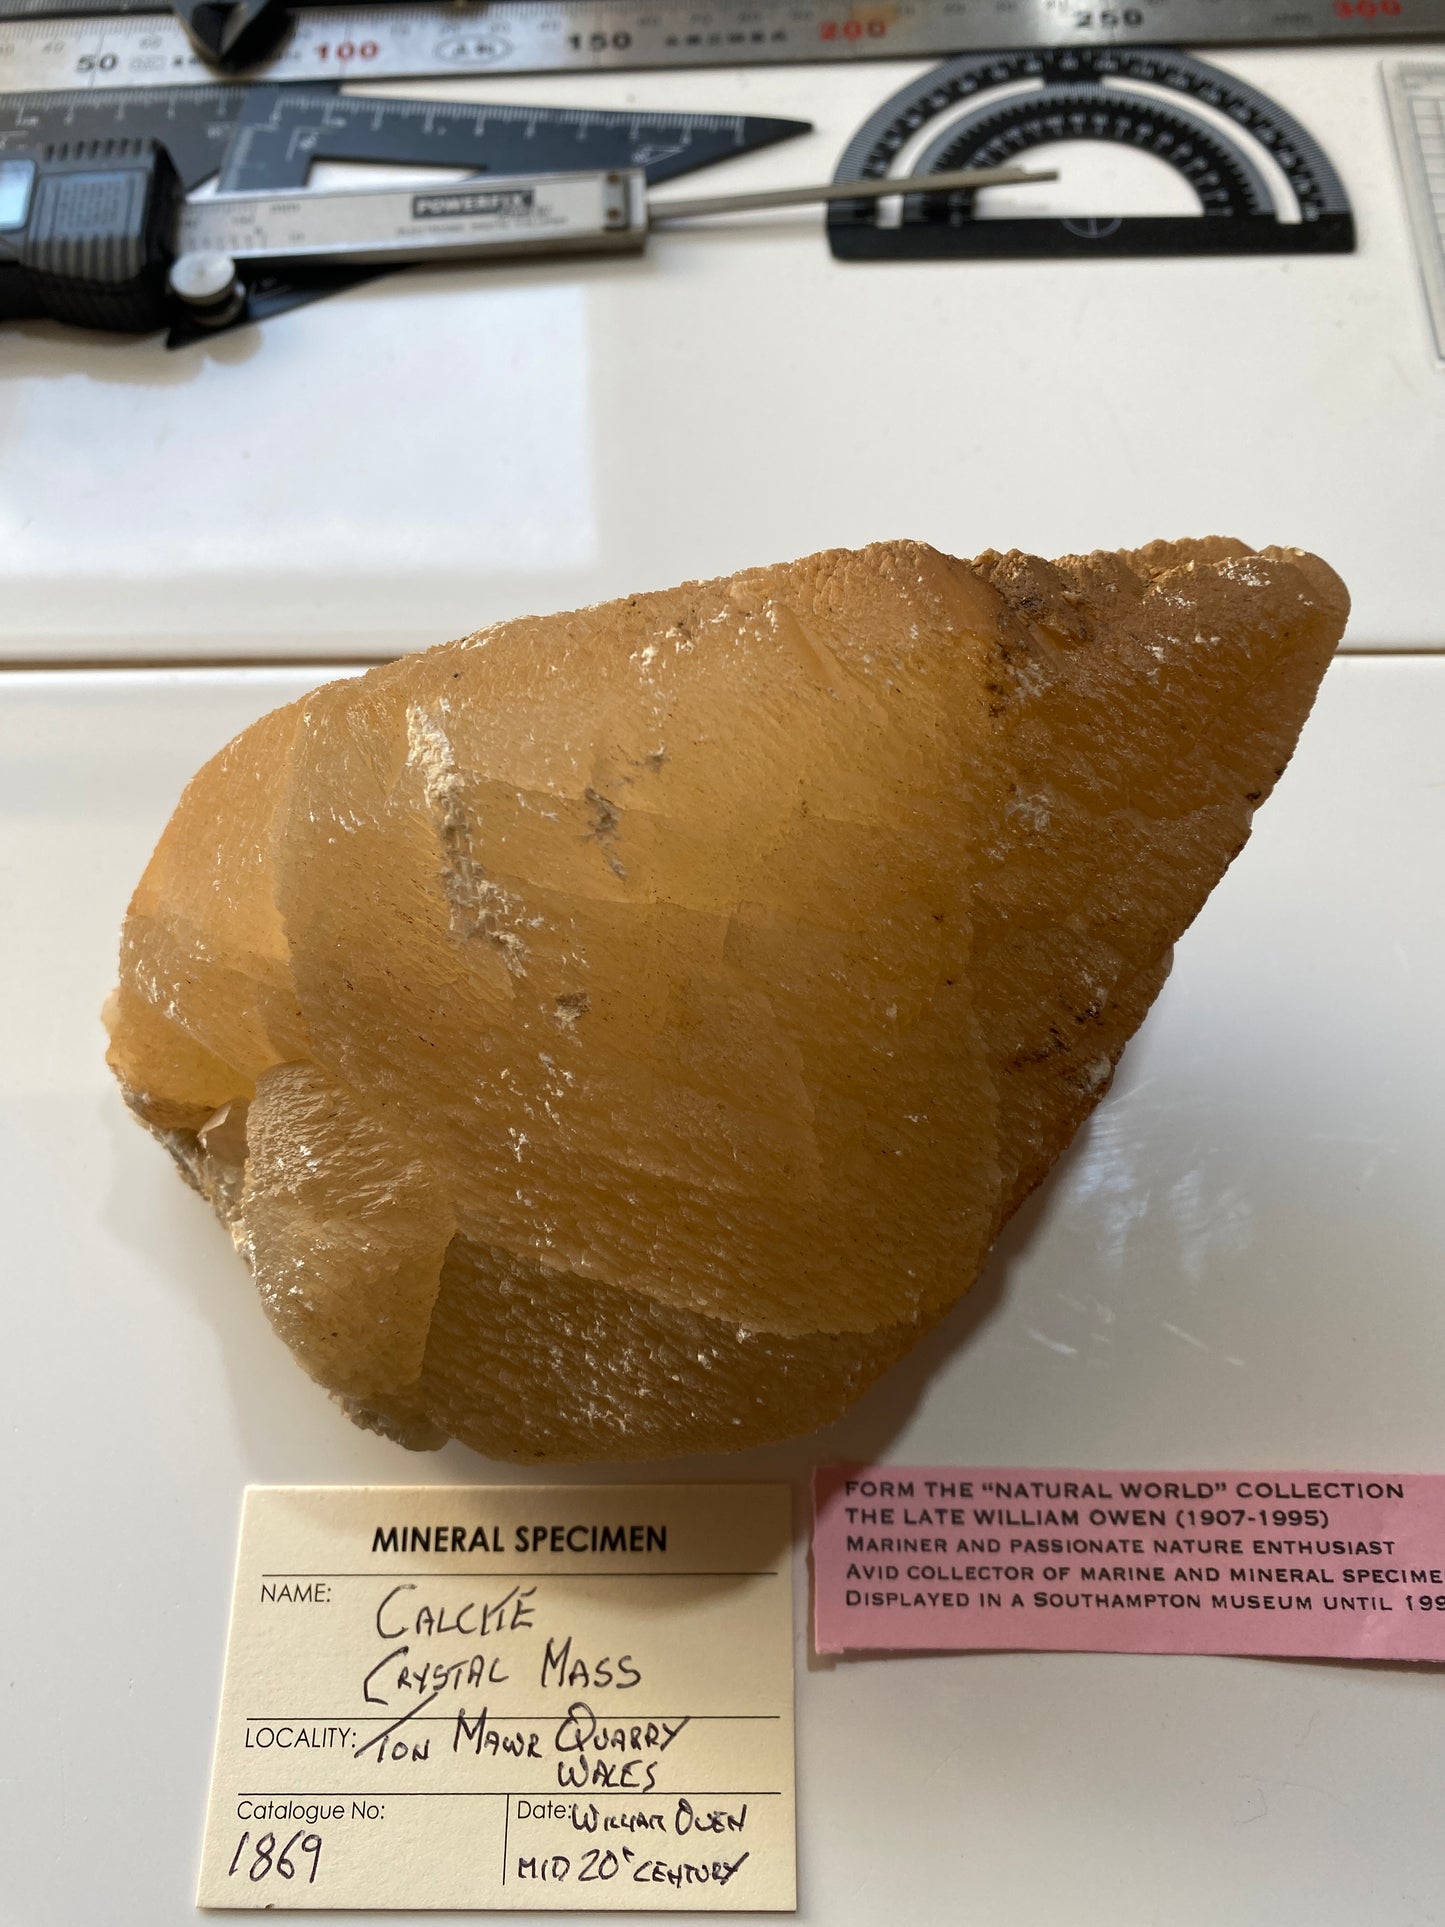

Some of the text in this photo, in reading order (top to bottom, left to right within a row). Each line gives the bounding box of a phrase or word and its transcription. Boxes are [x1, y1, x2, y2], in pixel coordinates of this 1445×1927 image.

[1074, 8, 1145, 29] 250
[568, 32, 632, 51] 150
[820, 21, 888, 41] 200
[314, 40, 379, 62] 100
[76, 53, 119, 74] 50
[845, 1481, 914, 1498] FORM
[925, 1481, 974, 1498] THE
[1236, 1482, 1405, 1499] COLLECTION
[845, 1508, 1330, 1529] THE LATE WILLIAM OWEN (1907-1995)
[371, 1525, 668, 1553] MINERAL SPECIMEN
[956, 1538, 1000, 1553] AND
[1010, 1538, 1145, 1554] PASSIONATE
[1153, 1539, 1244, 1554] NATURE
[1253, 1540, 1396, 1555] ENTHUSIAST
[907, 1565, 1034, 1581] COLLECTOR
[1043, 1566, 1071, 1581] OF
[1081, 1567, 1165, 1582] MARINE
[1174, 1567, 1220, 1582] AND
[1230, 1568, 1335, 1583] MINERAL
[260, 1583, 331, 1603] NAME:
[979, 1592, 1002, 1607] IN
[1010, 1592, 1025, 1607] A
[1211, 1594, 1313, 1610] MUSEUM
[1323, 1594, 1393, 1610] UNTIL
[245, 1727, 357, 1749] LOCALITY:
[557, 1754, 659, 1793] WALES
[237, 1800, 385, 1824] Catalogue No:
[517, 1800, 572, 1820] Date:
[228, 1829, 323, 1884] 1869
[518, 1855, 571, 1882] MID
